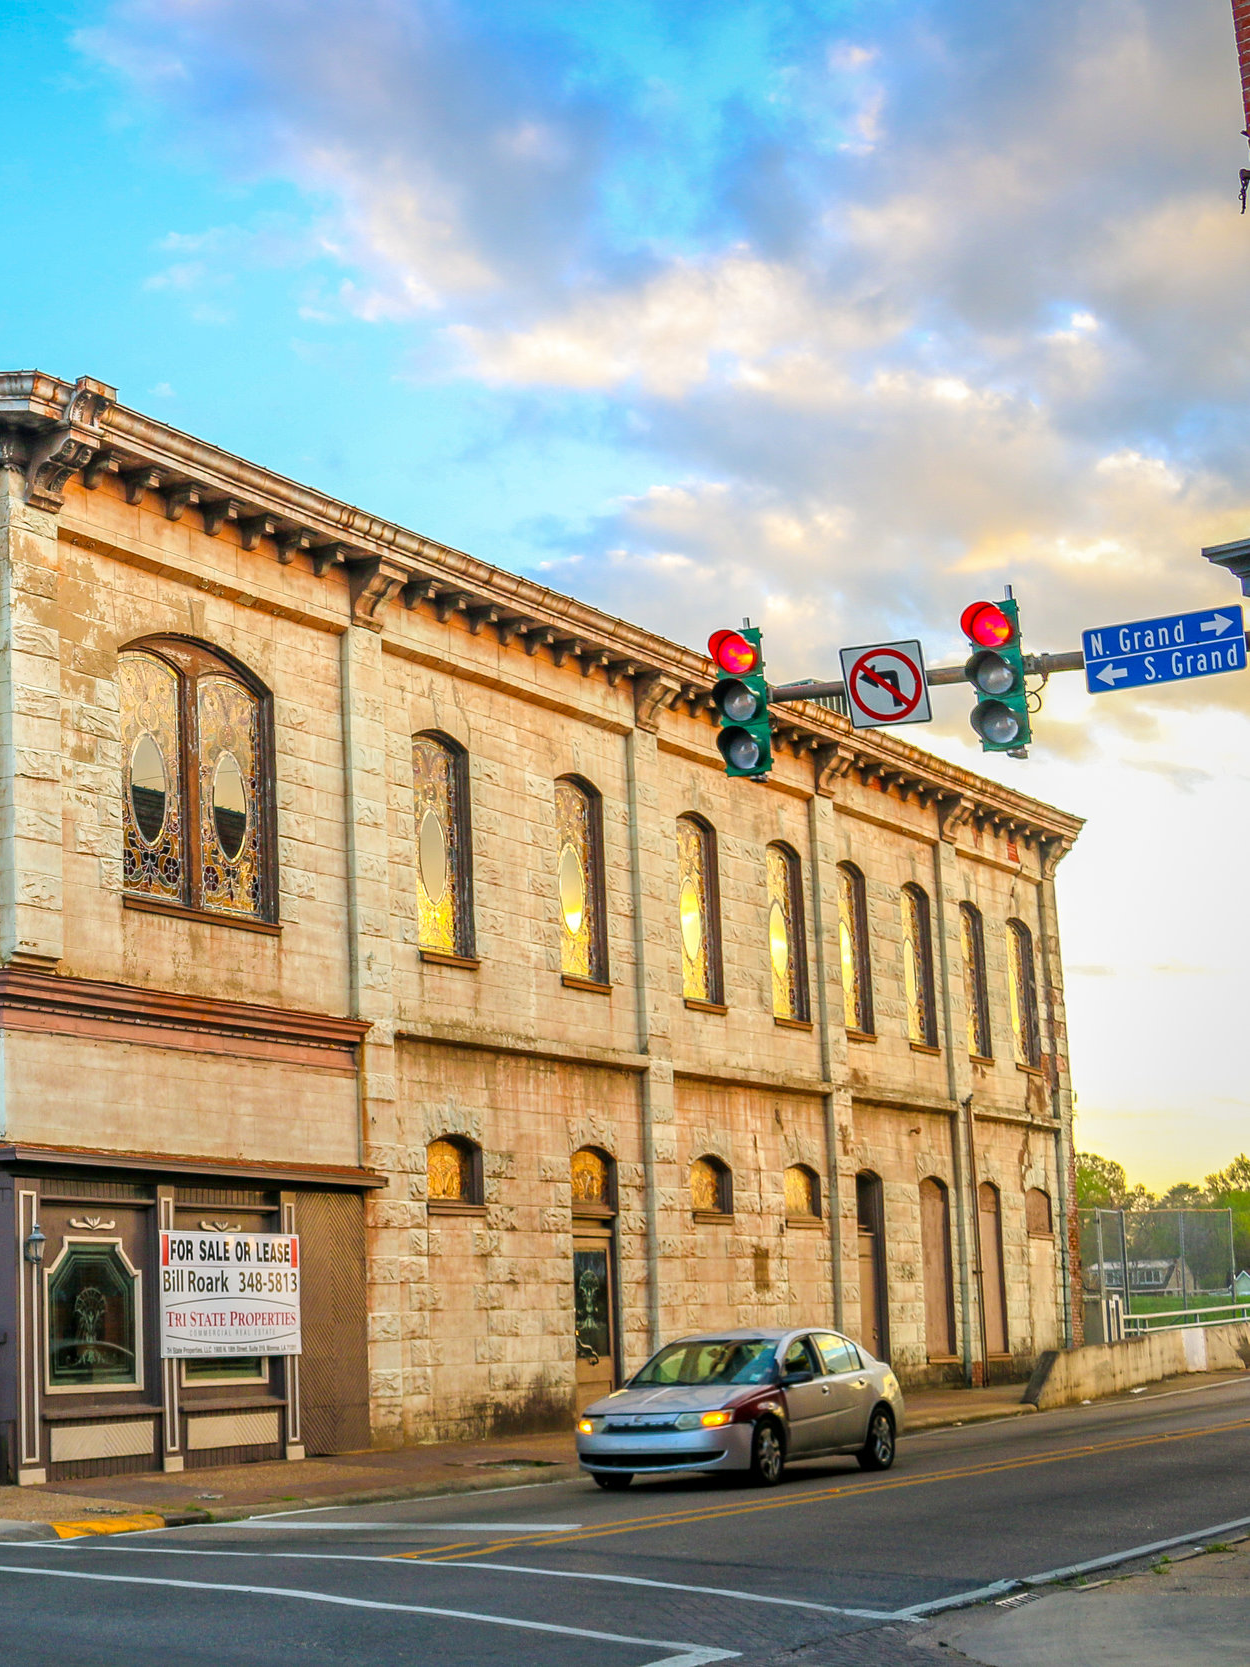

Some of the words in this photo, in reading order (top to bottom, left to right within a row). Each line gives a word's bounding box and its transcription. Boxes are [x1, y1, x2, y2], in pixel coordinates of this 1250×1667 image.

[1090, 632, 1110, 657] N.
[1119, 620, 1185, 653] Grand
[1144, 656, 1162, 681] S.
[1171, 643, 1238, 676] Grand
[170, 1239, 194, 1261] FOR
[199, 1239, 230, 1261] SALE
[235, 1241, 251, 1262] OR
[256, 1242, 291, 1263] LEASE
[163, 1269, 184, 1292] Bill
[188, 1270, 229, 1293] Roark
[238, 1272, 297, 1293] 348-5813
[166, 1311, 186, 1327] TRI
[190, 1311, 226, 1327] STATE
[230, 1311, 296, 1326] PROPERTIES
[190, 1329, 232, 1337] COMMERCIAL
[254, 1328, 276, 1336] ESTATE
